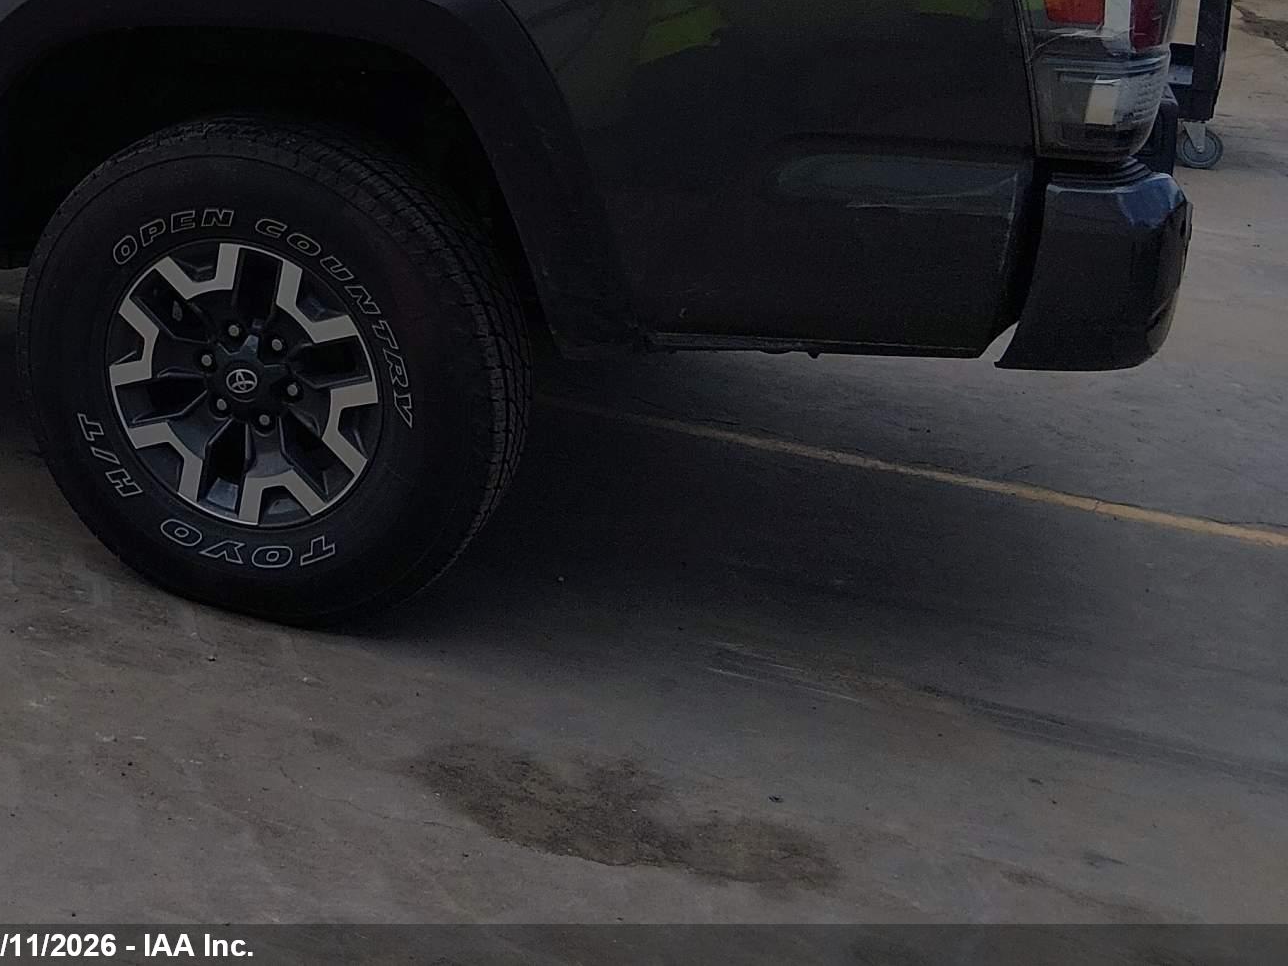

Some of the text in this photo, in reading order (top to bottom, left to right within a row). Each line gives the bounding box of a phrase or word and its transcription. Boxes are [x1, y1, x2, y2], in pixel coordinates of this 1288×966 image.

[113, 208, 413, 429] OPEN COUNTRY
[77, 412, 144, 498] H/T
[160, 518, 336, 568] TOYO
